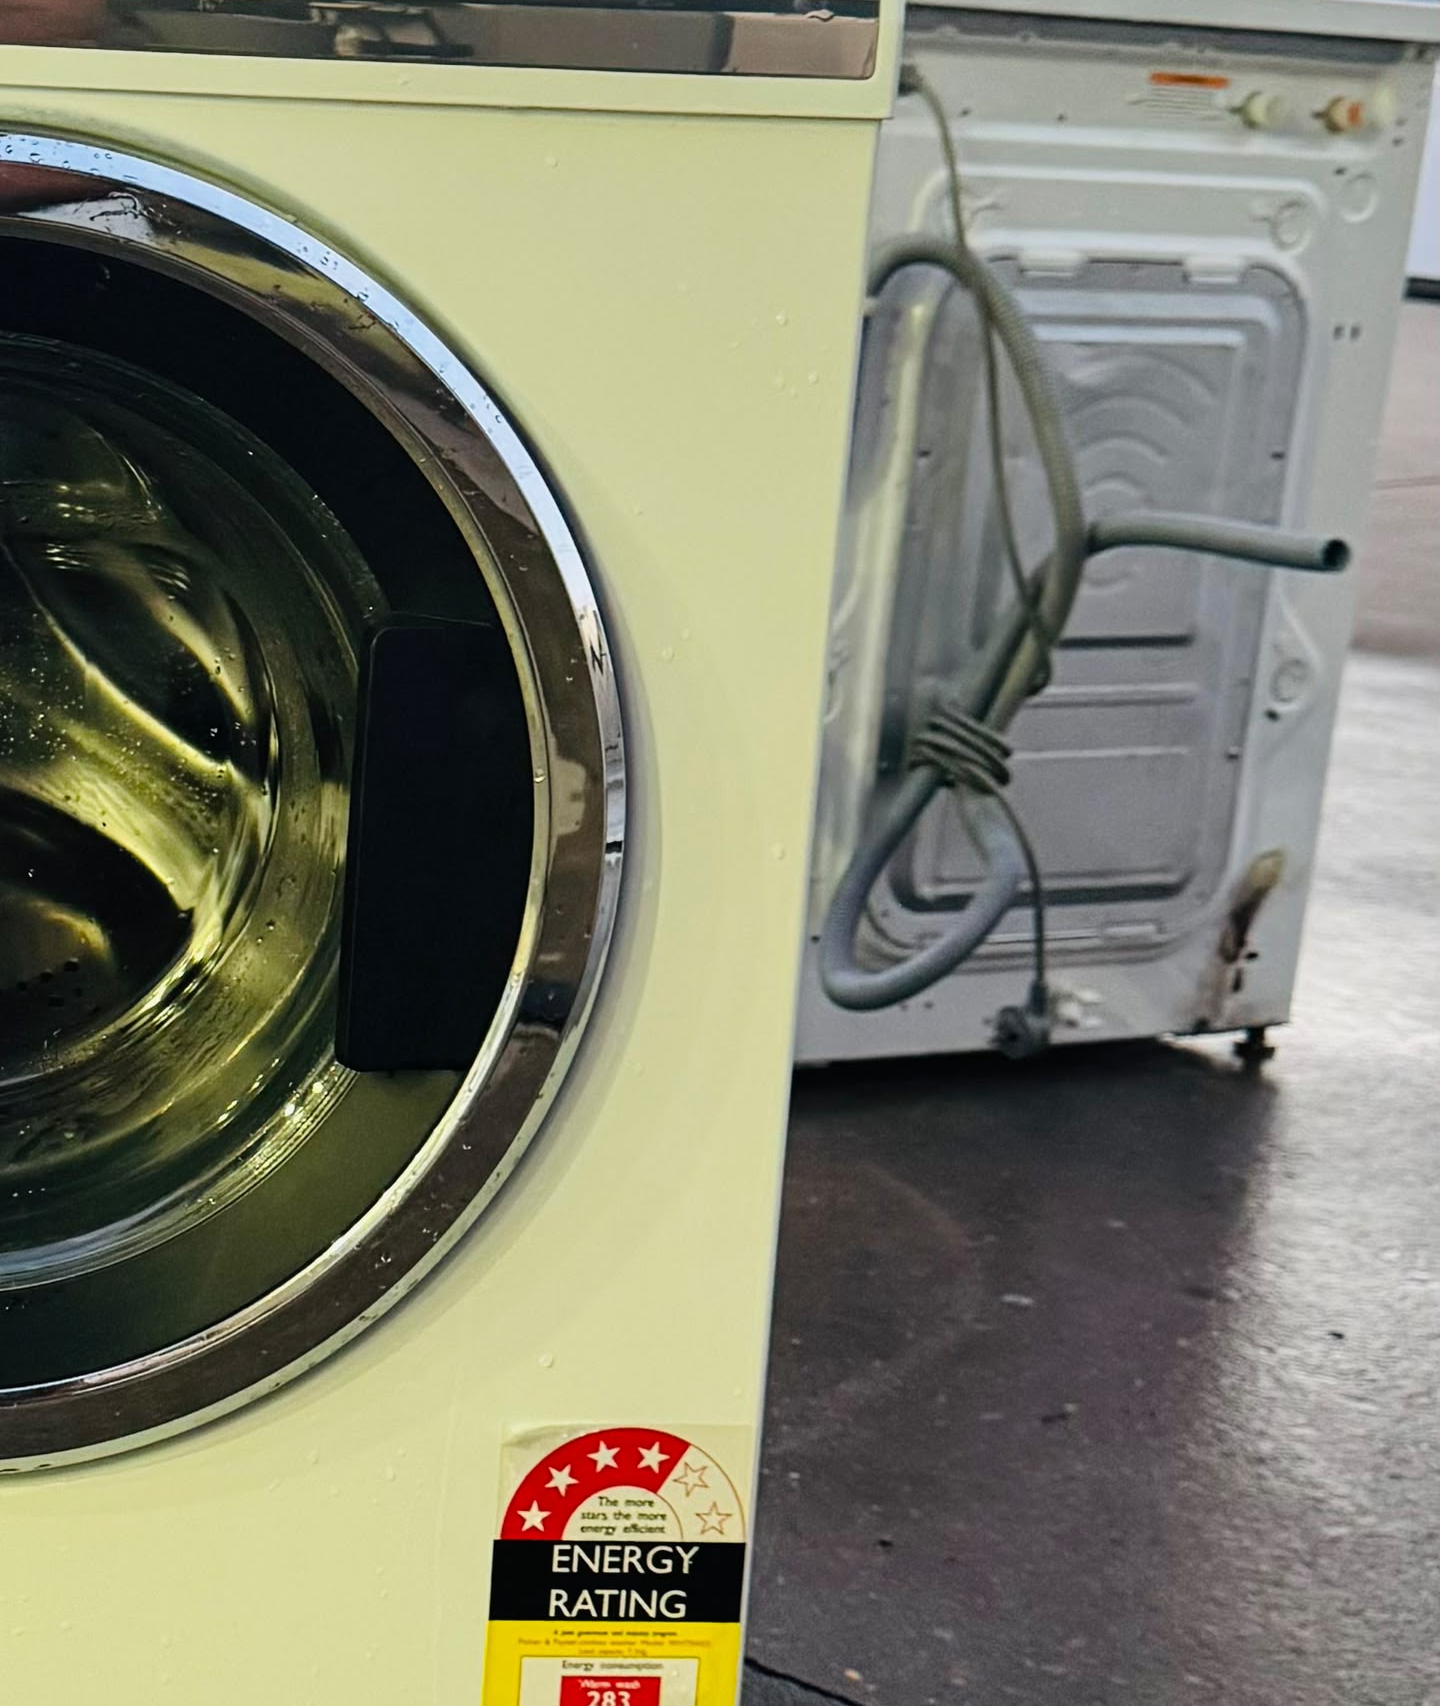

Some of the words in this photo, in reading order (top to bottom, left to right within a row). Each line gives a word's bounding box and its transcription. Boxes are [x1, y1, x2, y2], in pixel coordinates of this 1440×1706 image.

[598, 1496, 619, 1507] The
[623, 1498, 655, 1508] more
[580, 1510, 608, 1521] stars
[613, 1509, 633, 1521] the
[637, 1512, 667, 1522] more
[580, 1524, 617, 1536] energy
[622, 1523, 665, 1534] efficient
[551, 1544, 699, 1574] ENERGY
[548, 1588, 687, 1619] RATING
